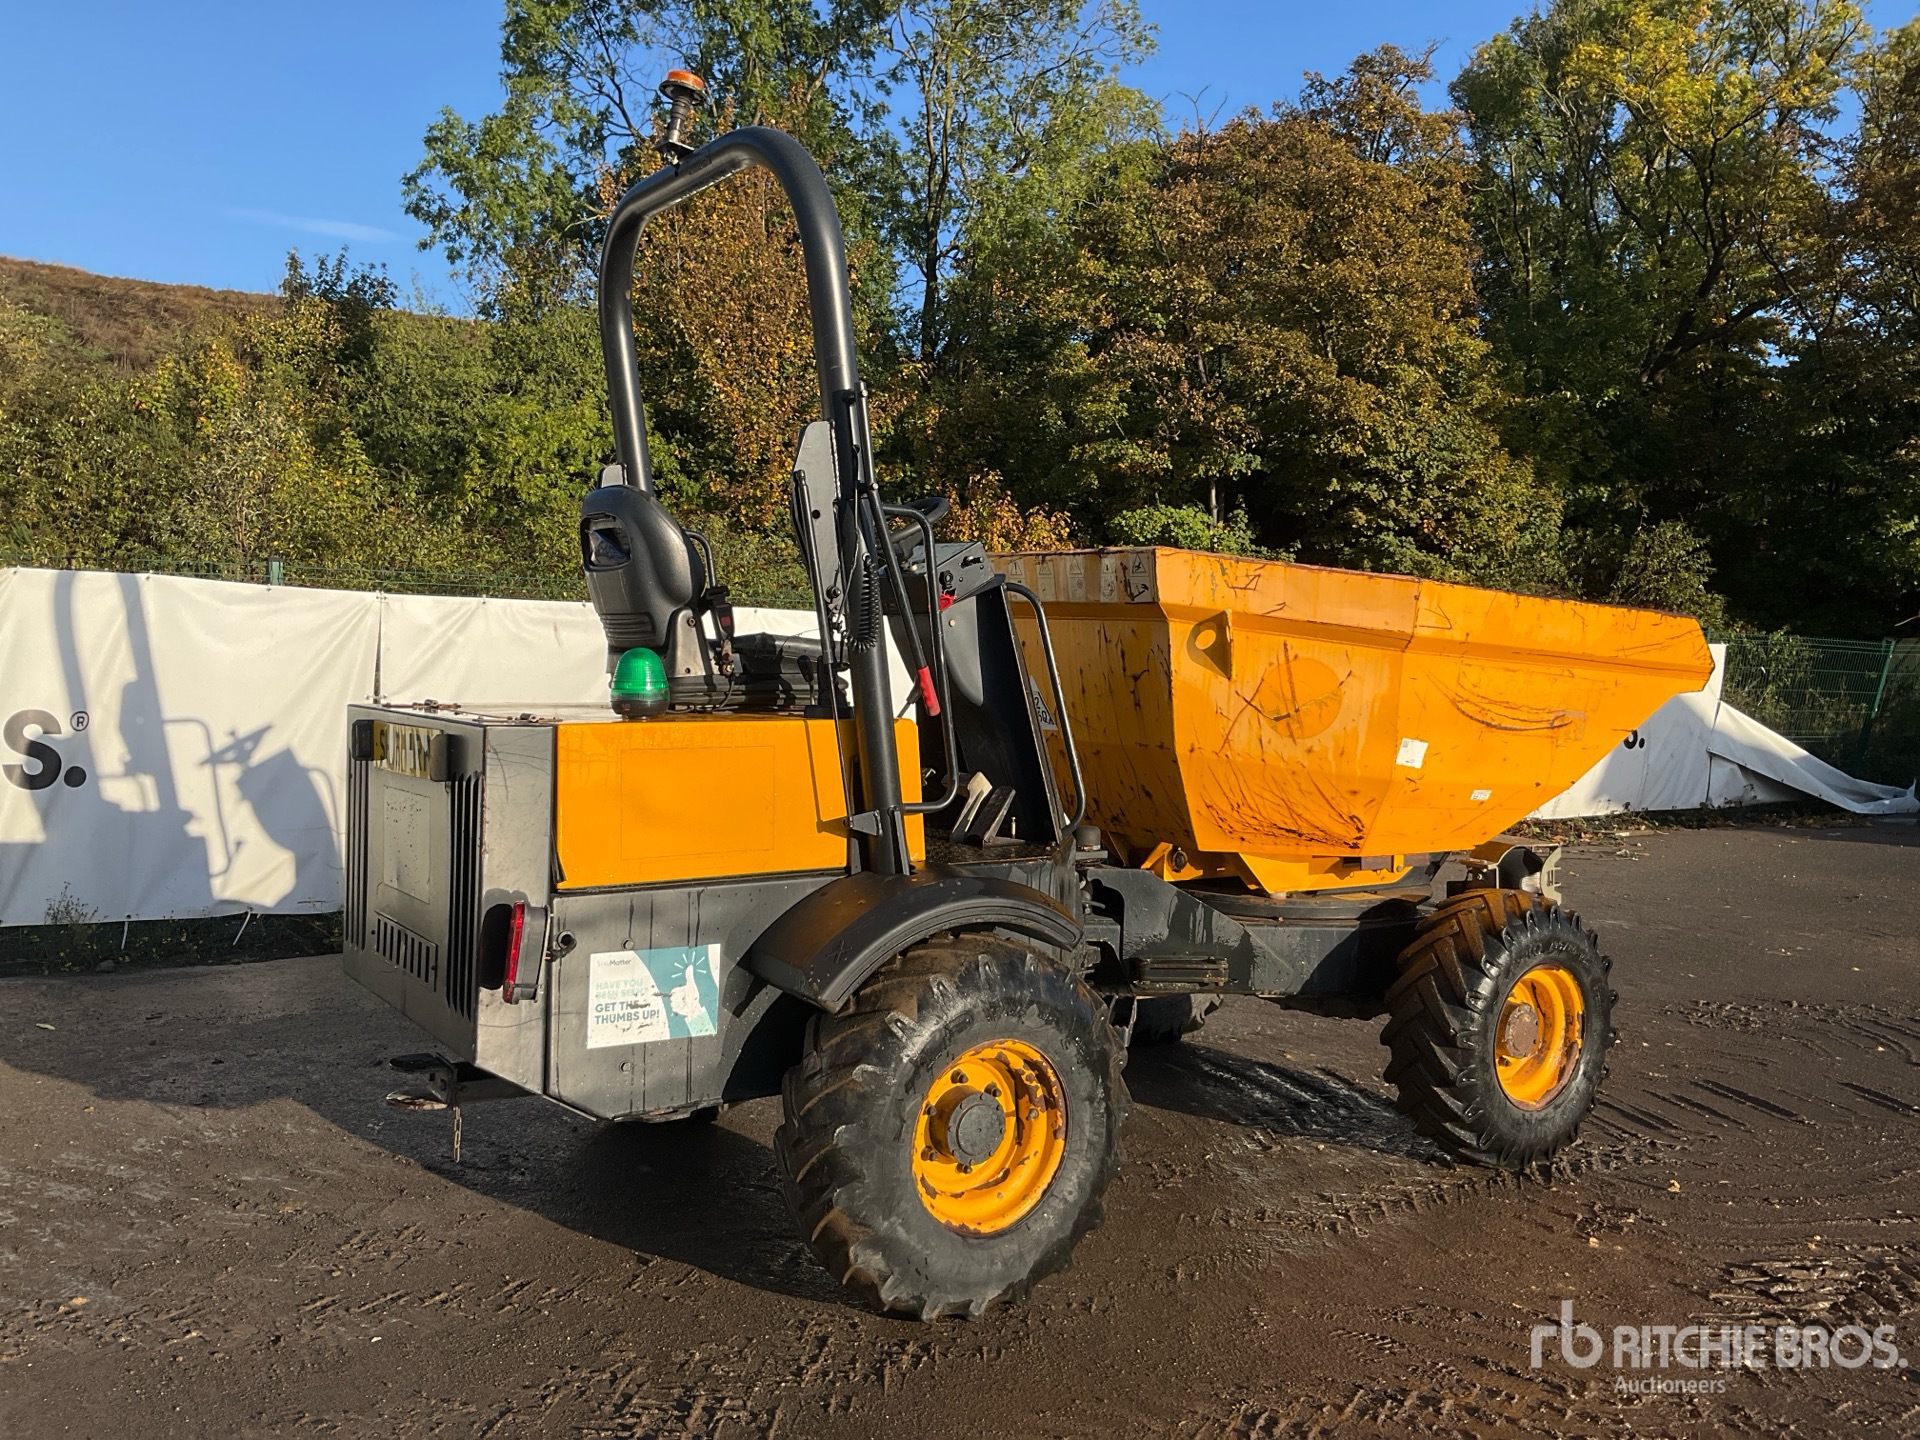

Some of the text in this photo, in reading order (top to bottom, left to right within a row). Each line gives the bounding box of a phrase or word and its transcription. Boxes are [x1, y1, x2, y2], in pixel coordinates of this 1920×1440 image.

[596, 978, 643, 990] HAVE YOU
[594, 1001, 617, 1013] GET
[594, 1009, 660, 1025] THUMBS UP!
